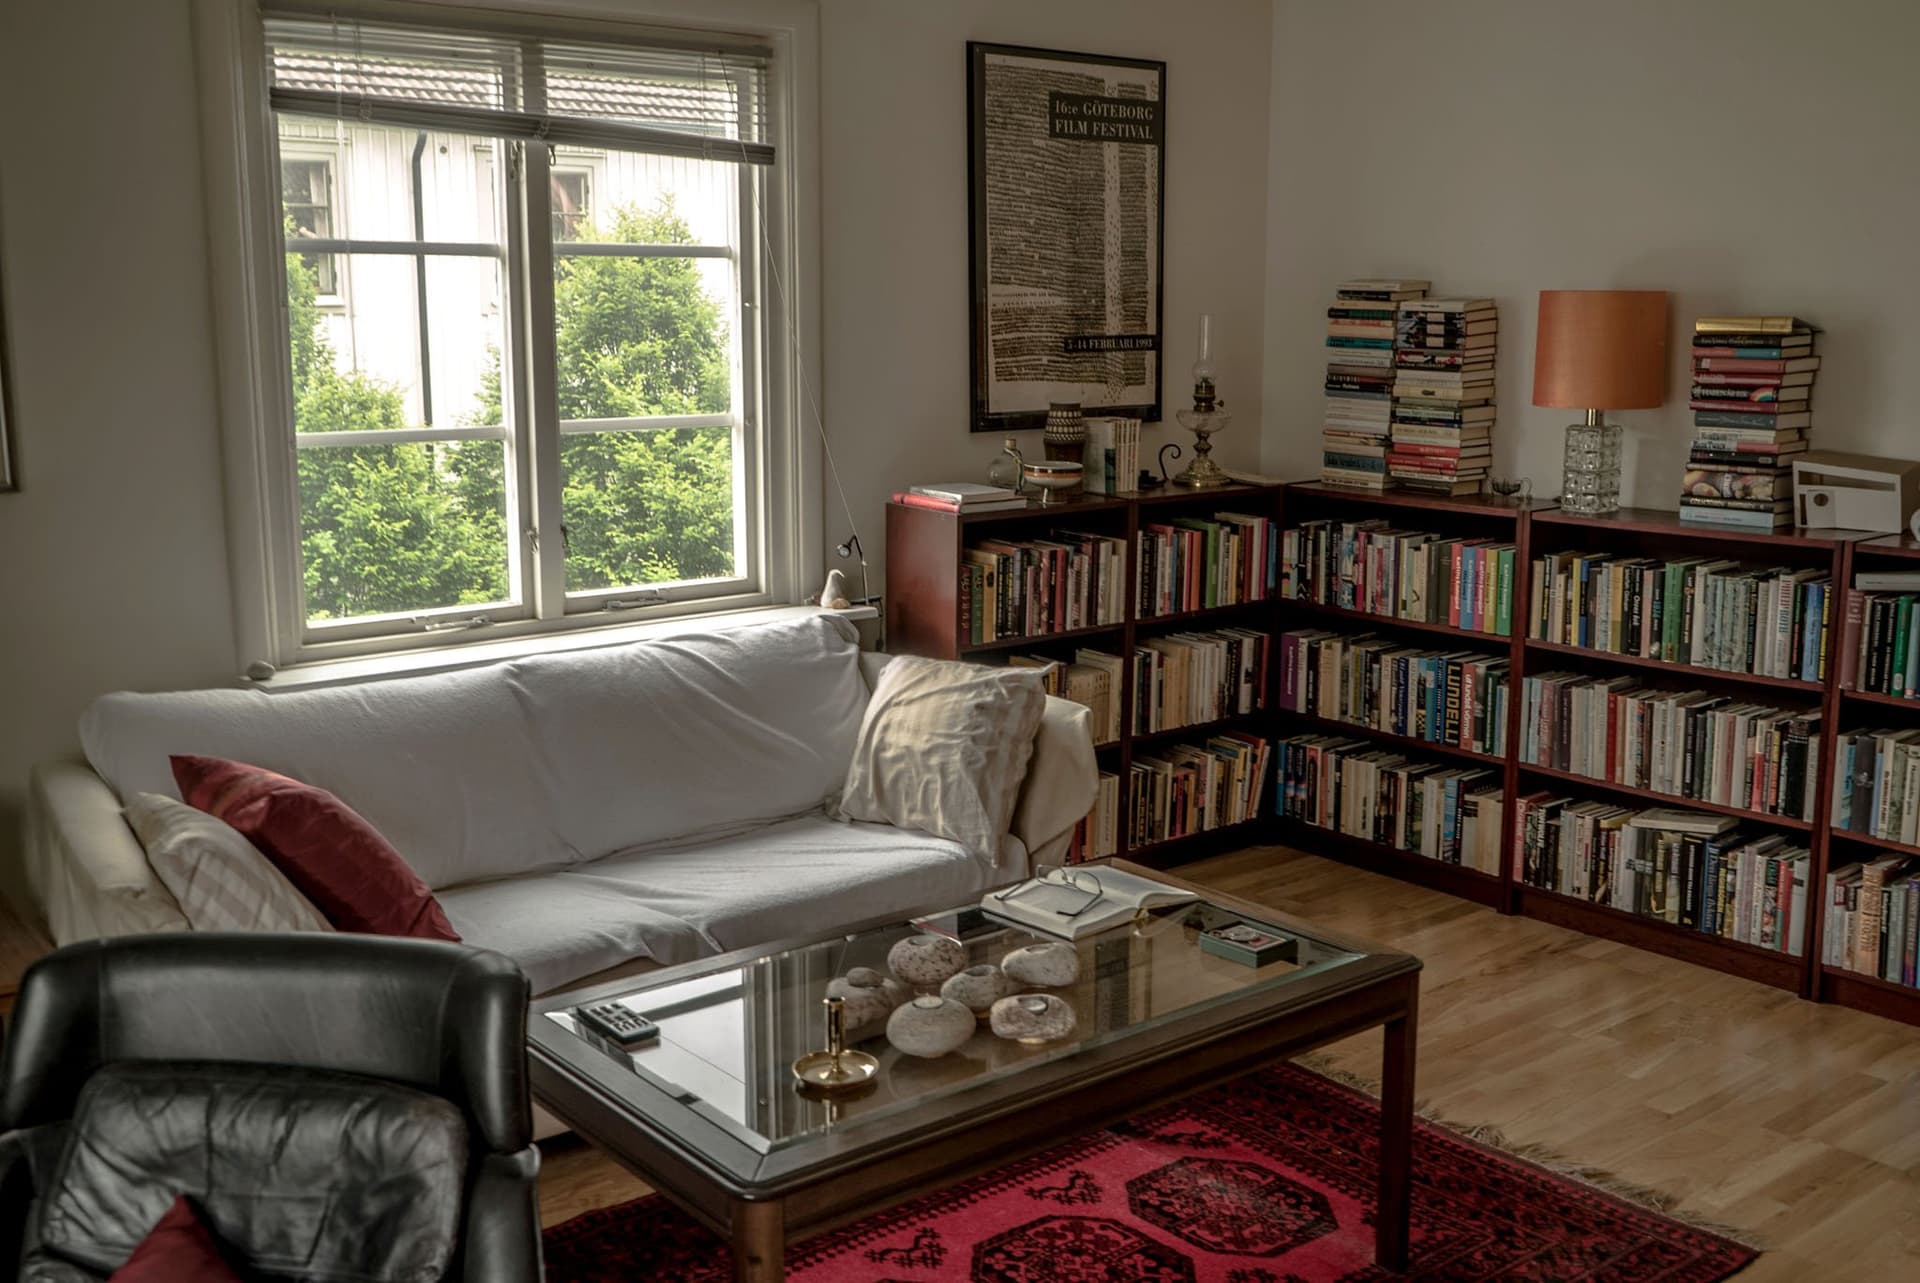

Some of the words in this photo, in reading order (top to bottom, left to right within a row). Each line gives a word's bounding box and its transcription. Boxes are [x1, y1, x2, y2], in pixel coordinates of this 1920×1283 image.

[1056, 100, 1078, 115] 16:e
[1083, 101, 1153, 120] GÖTEBORG
[1055, 119, 1088, 135] FILM
[1093, 122, 1152, 139] FESTIVAL
[1089, 338, 1133, 350] FEBRUARI
[1136, 338, 1152, 348] 1993
[1445, 665, 1461, 738] LUNDELL
